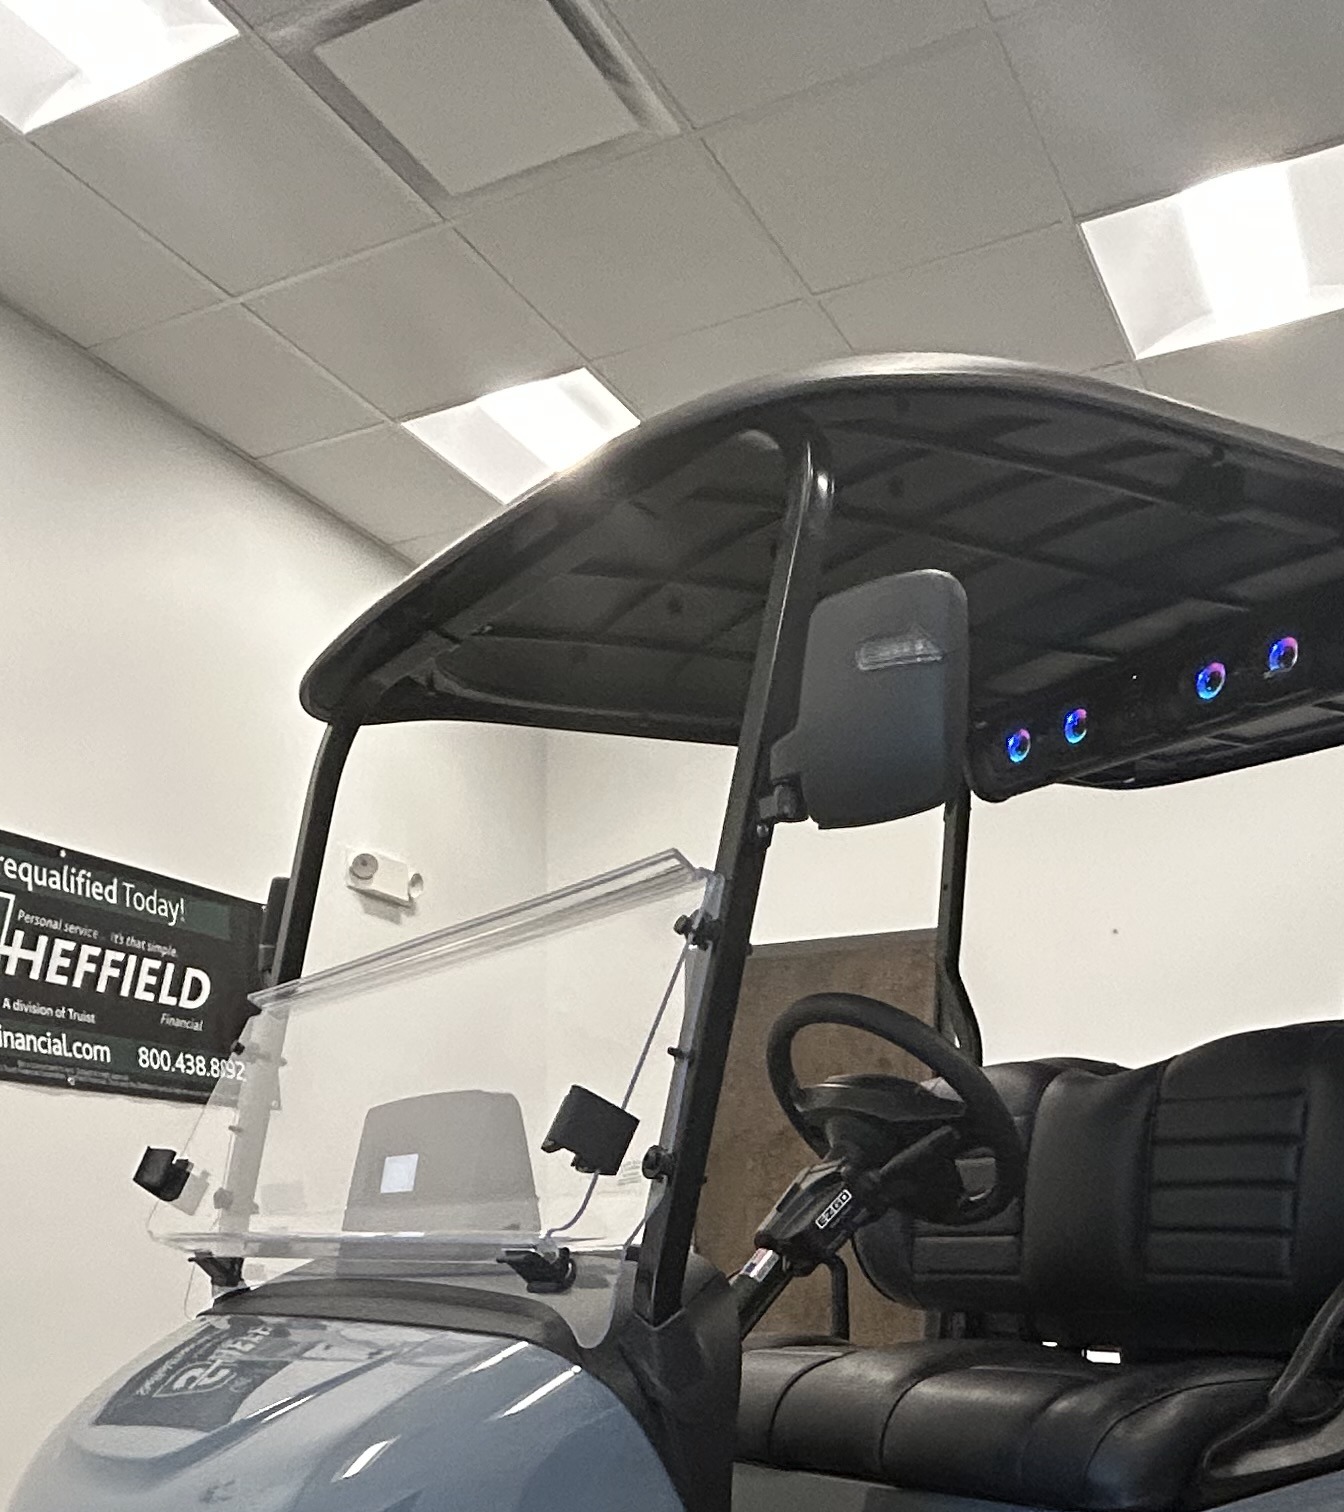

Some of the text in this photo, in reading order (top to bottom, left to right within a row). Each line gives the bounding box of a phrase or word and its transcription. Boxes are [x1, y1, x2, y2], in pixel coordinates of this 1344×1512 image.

[121, 881, 186, 927] Today!
[17, 908, 63, 931] Personal
[2, 997, 97, 1025] A division of Truist
[159, 1013, 204, 1032] Financial
